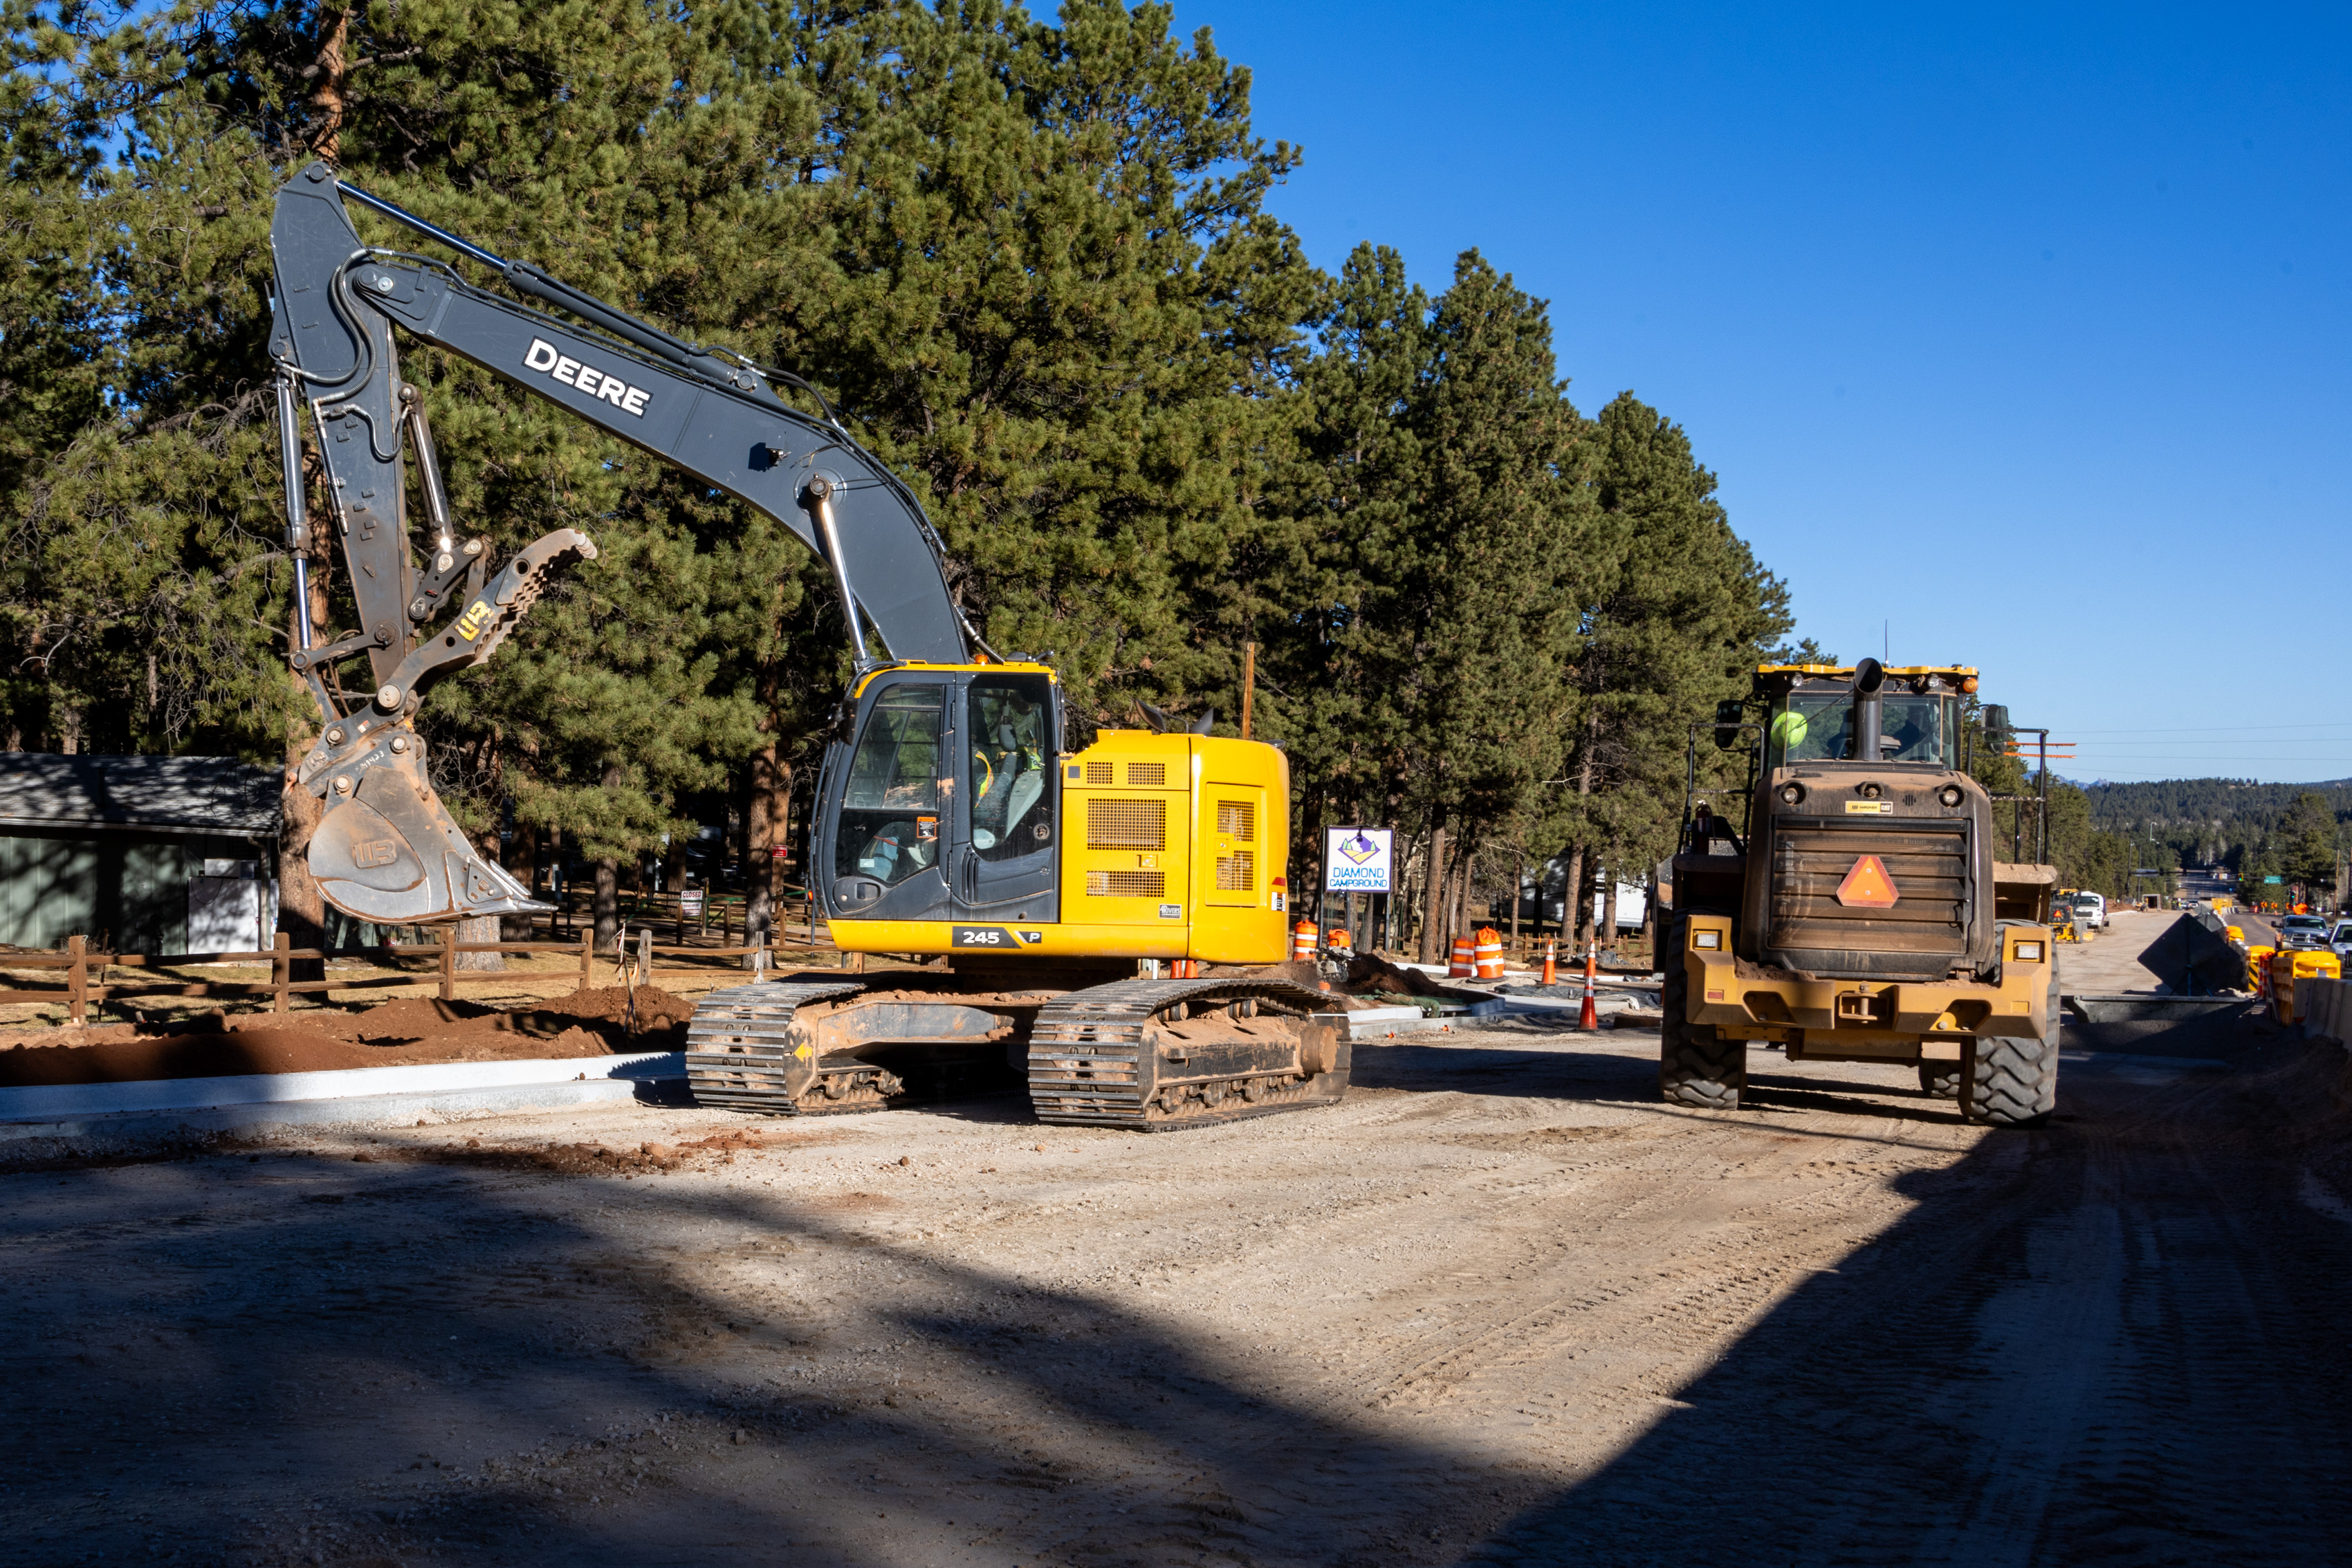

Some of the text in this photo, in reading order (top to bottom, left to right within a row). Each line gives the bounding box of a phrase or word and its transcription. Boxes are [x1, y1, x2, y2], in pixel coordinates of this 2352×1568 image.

[524, 338, 650, 416] DEERE
[1333, 867, 1384, 878] DIAMOND
[1330, 879, 1387, 887] CAMPGROUND
[963, 931, 1040, 944] 245 P
